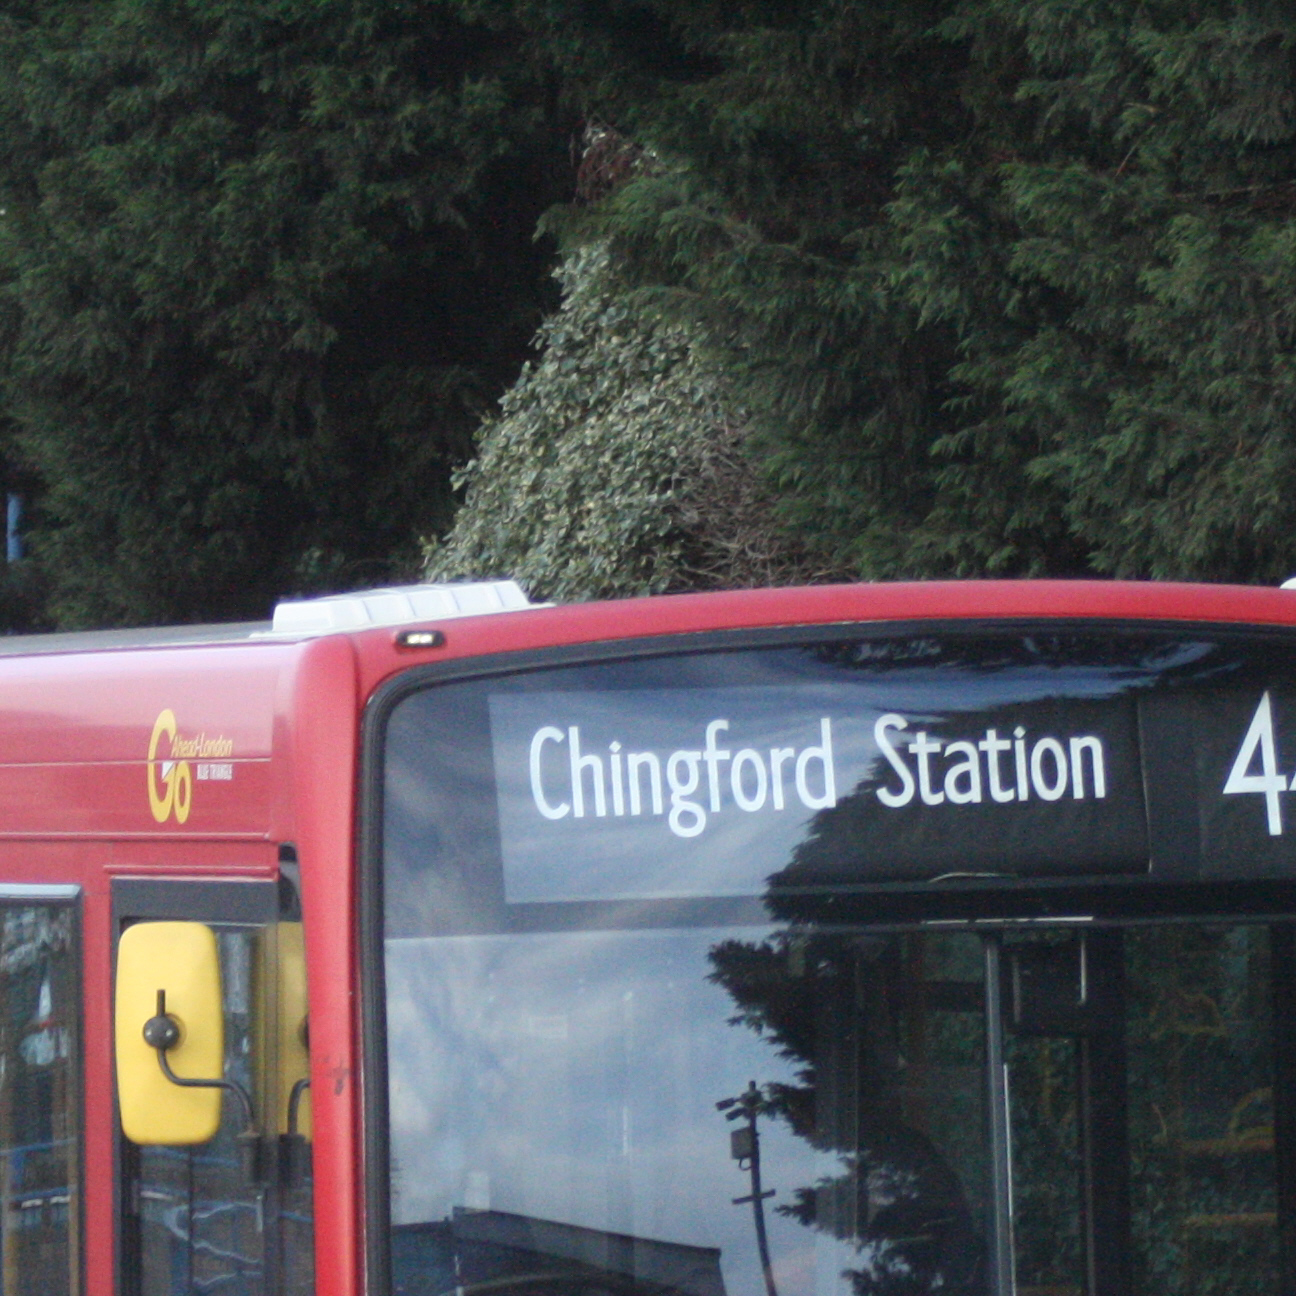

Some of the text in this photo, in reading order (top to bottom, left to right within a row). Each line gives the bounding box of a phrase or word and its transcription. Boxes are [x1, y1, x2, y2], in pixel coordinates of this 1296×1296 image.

[147, 708, 191, 825] Go
[528, 713, 1106, 838] Chingford Station
